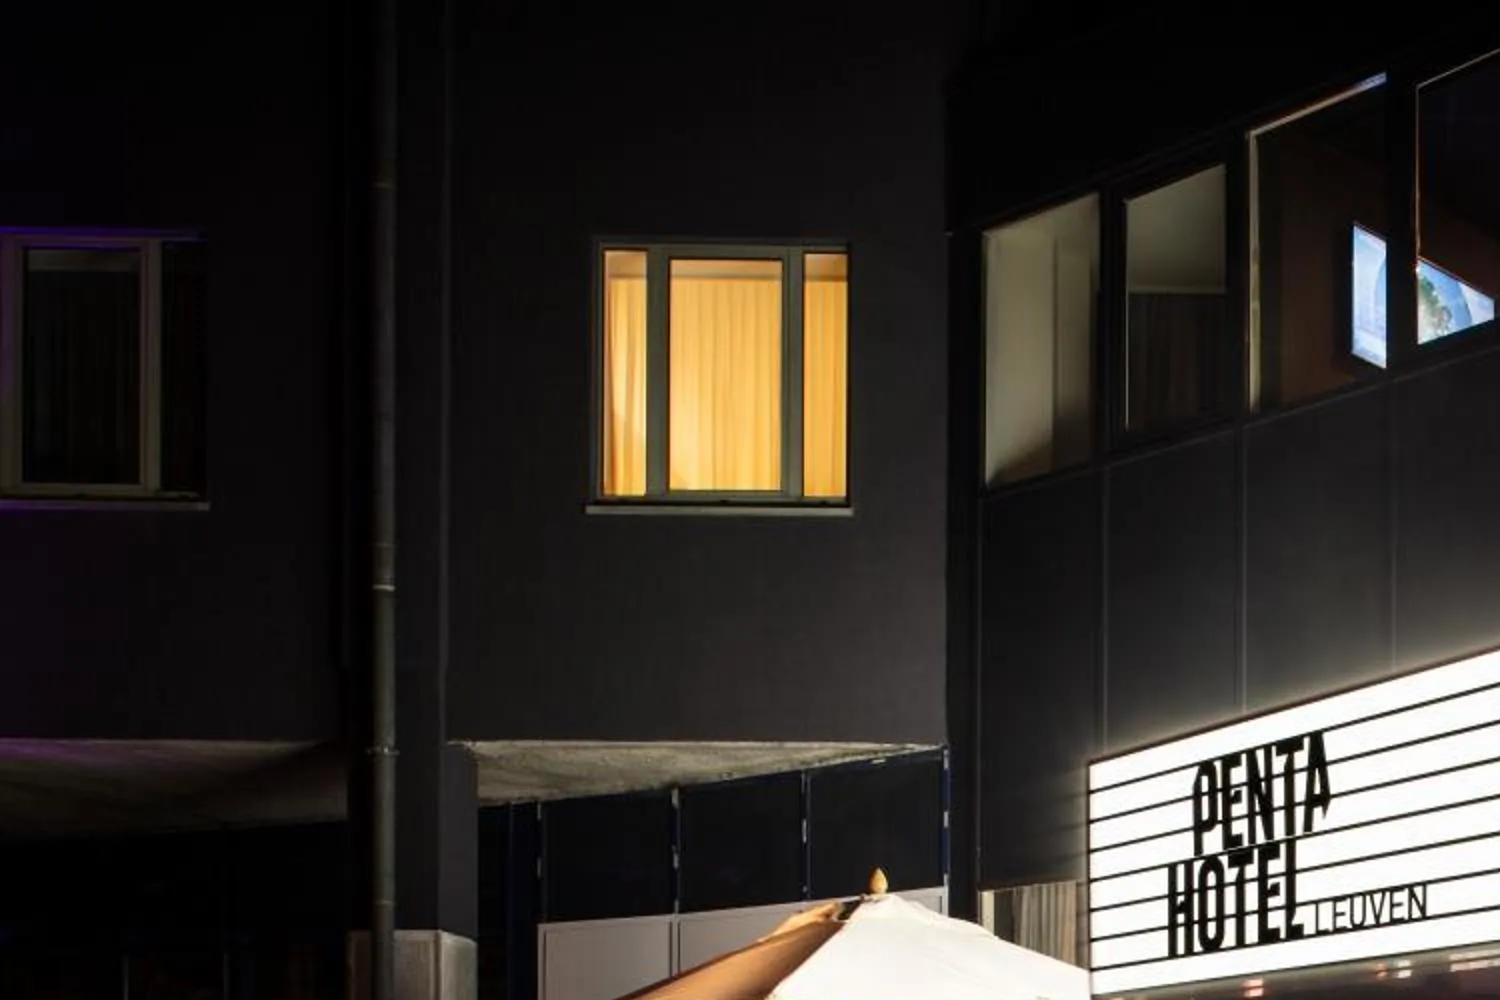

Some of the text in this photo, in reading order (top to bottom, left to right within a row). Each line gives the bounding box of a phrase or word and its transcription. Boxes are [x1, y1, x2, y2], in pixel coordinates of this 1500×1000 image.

[1193, 731, 1330, 856] PENTA
[1168, 840, 1427, 957] HOTEL LEUVEN
